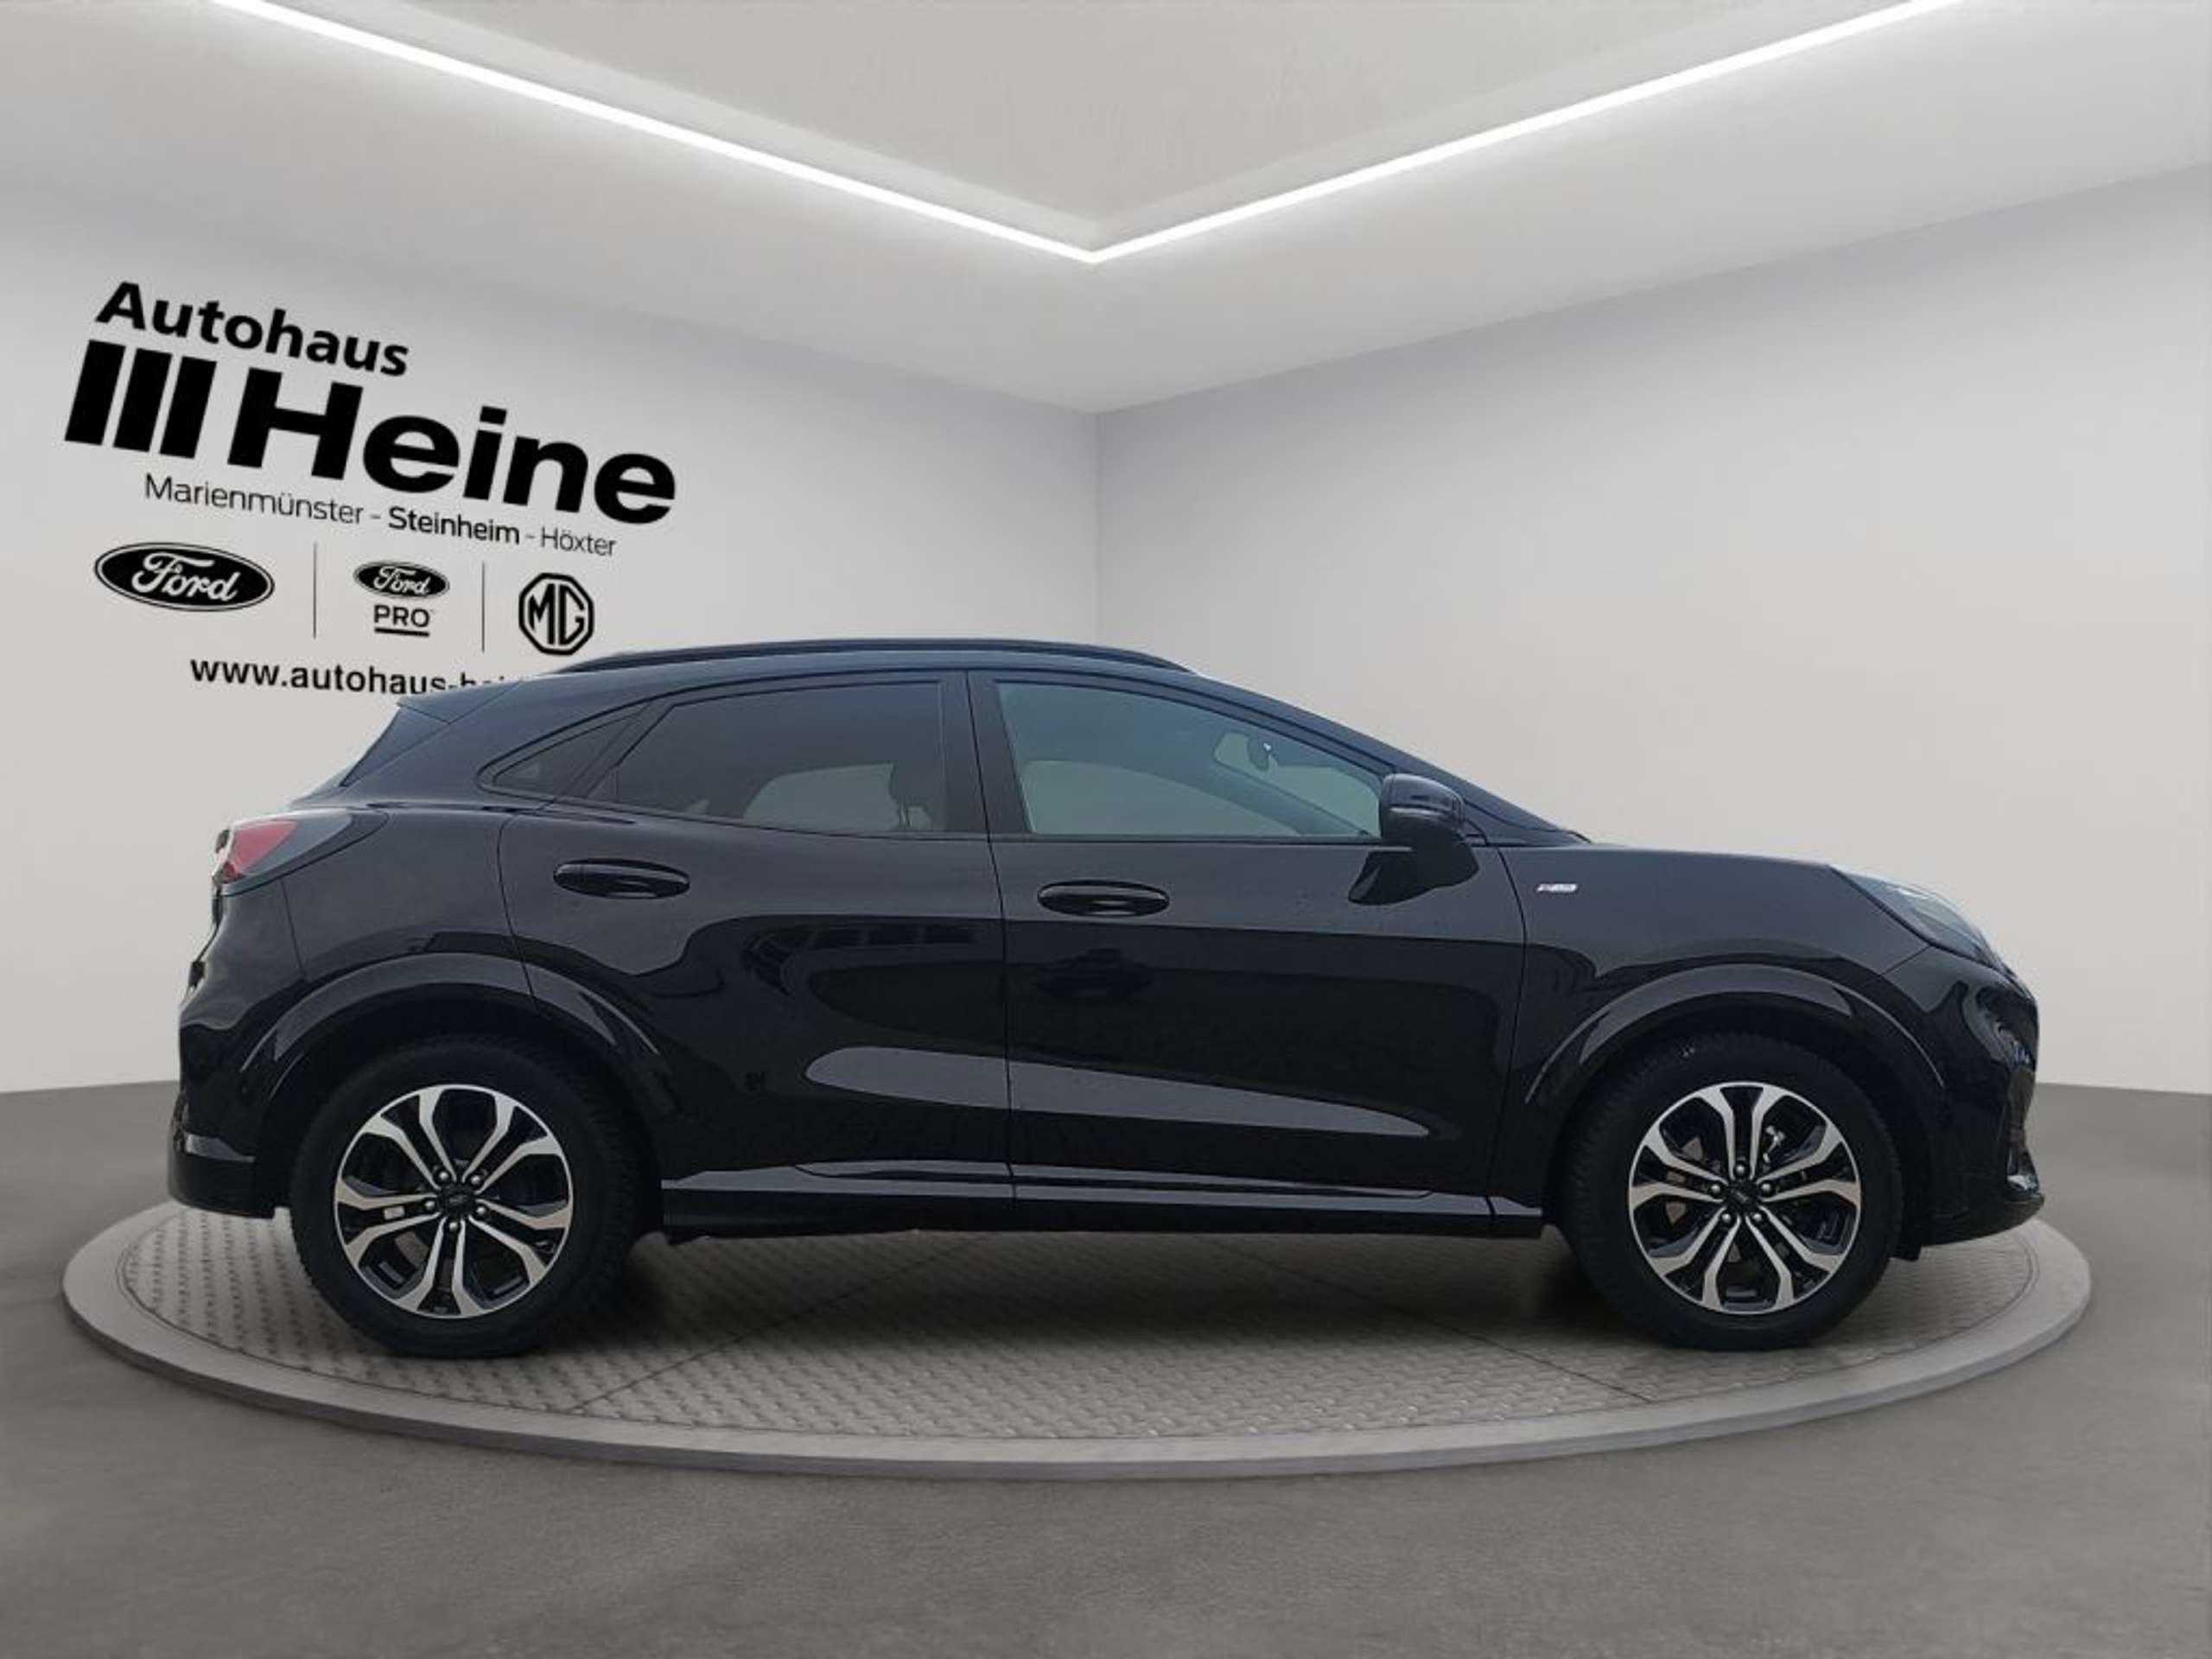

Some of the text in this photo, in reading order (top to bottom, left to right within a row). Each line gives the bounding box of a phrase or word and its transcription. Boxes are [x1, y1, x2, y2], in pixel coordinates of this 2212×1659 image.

[96, 281, 409, 377] Autohaus
[227, 367, 676, 524] Heine
[144, 473, 364, 524] Marienmünster
[387, 506, 520, 545] Steinheim
[541, 528, 616, 557] Höxter
[131, 551, 241, 602] Ford
[372, 564, 431, 595] Ford
[373, 604, 430, 627] PRO
[528, 582, 585, 645] MG
